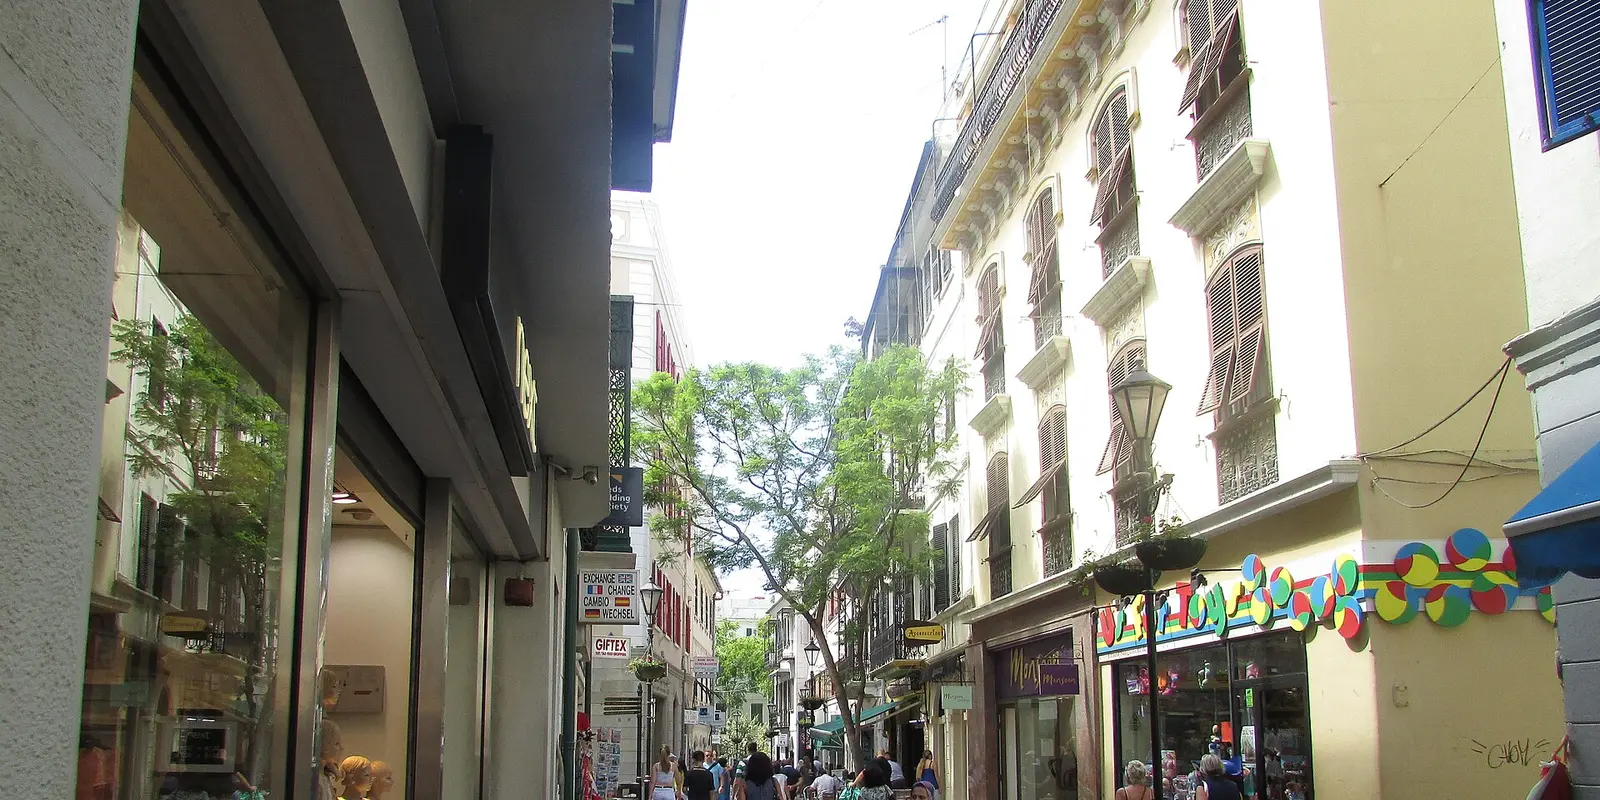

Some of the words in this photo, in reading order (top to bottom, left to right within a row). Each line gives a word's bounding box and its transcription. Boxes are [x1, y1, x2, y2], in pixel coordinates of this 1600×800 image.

[583, 573, 616, 584] EXCHANGE
[607, 585, 635, 595] CHANGE
[583, 596, 610, 607] CAMBIO
[602, 608, 635, 619] WECHSEL
[1131, 592, 1171, 642] fr
[1175, 580, 1245, 638] Toys
[596, 639, 627, 651] GIFTEX
